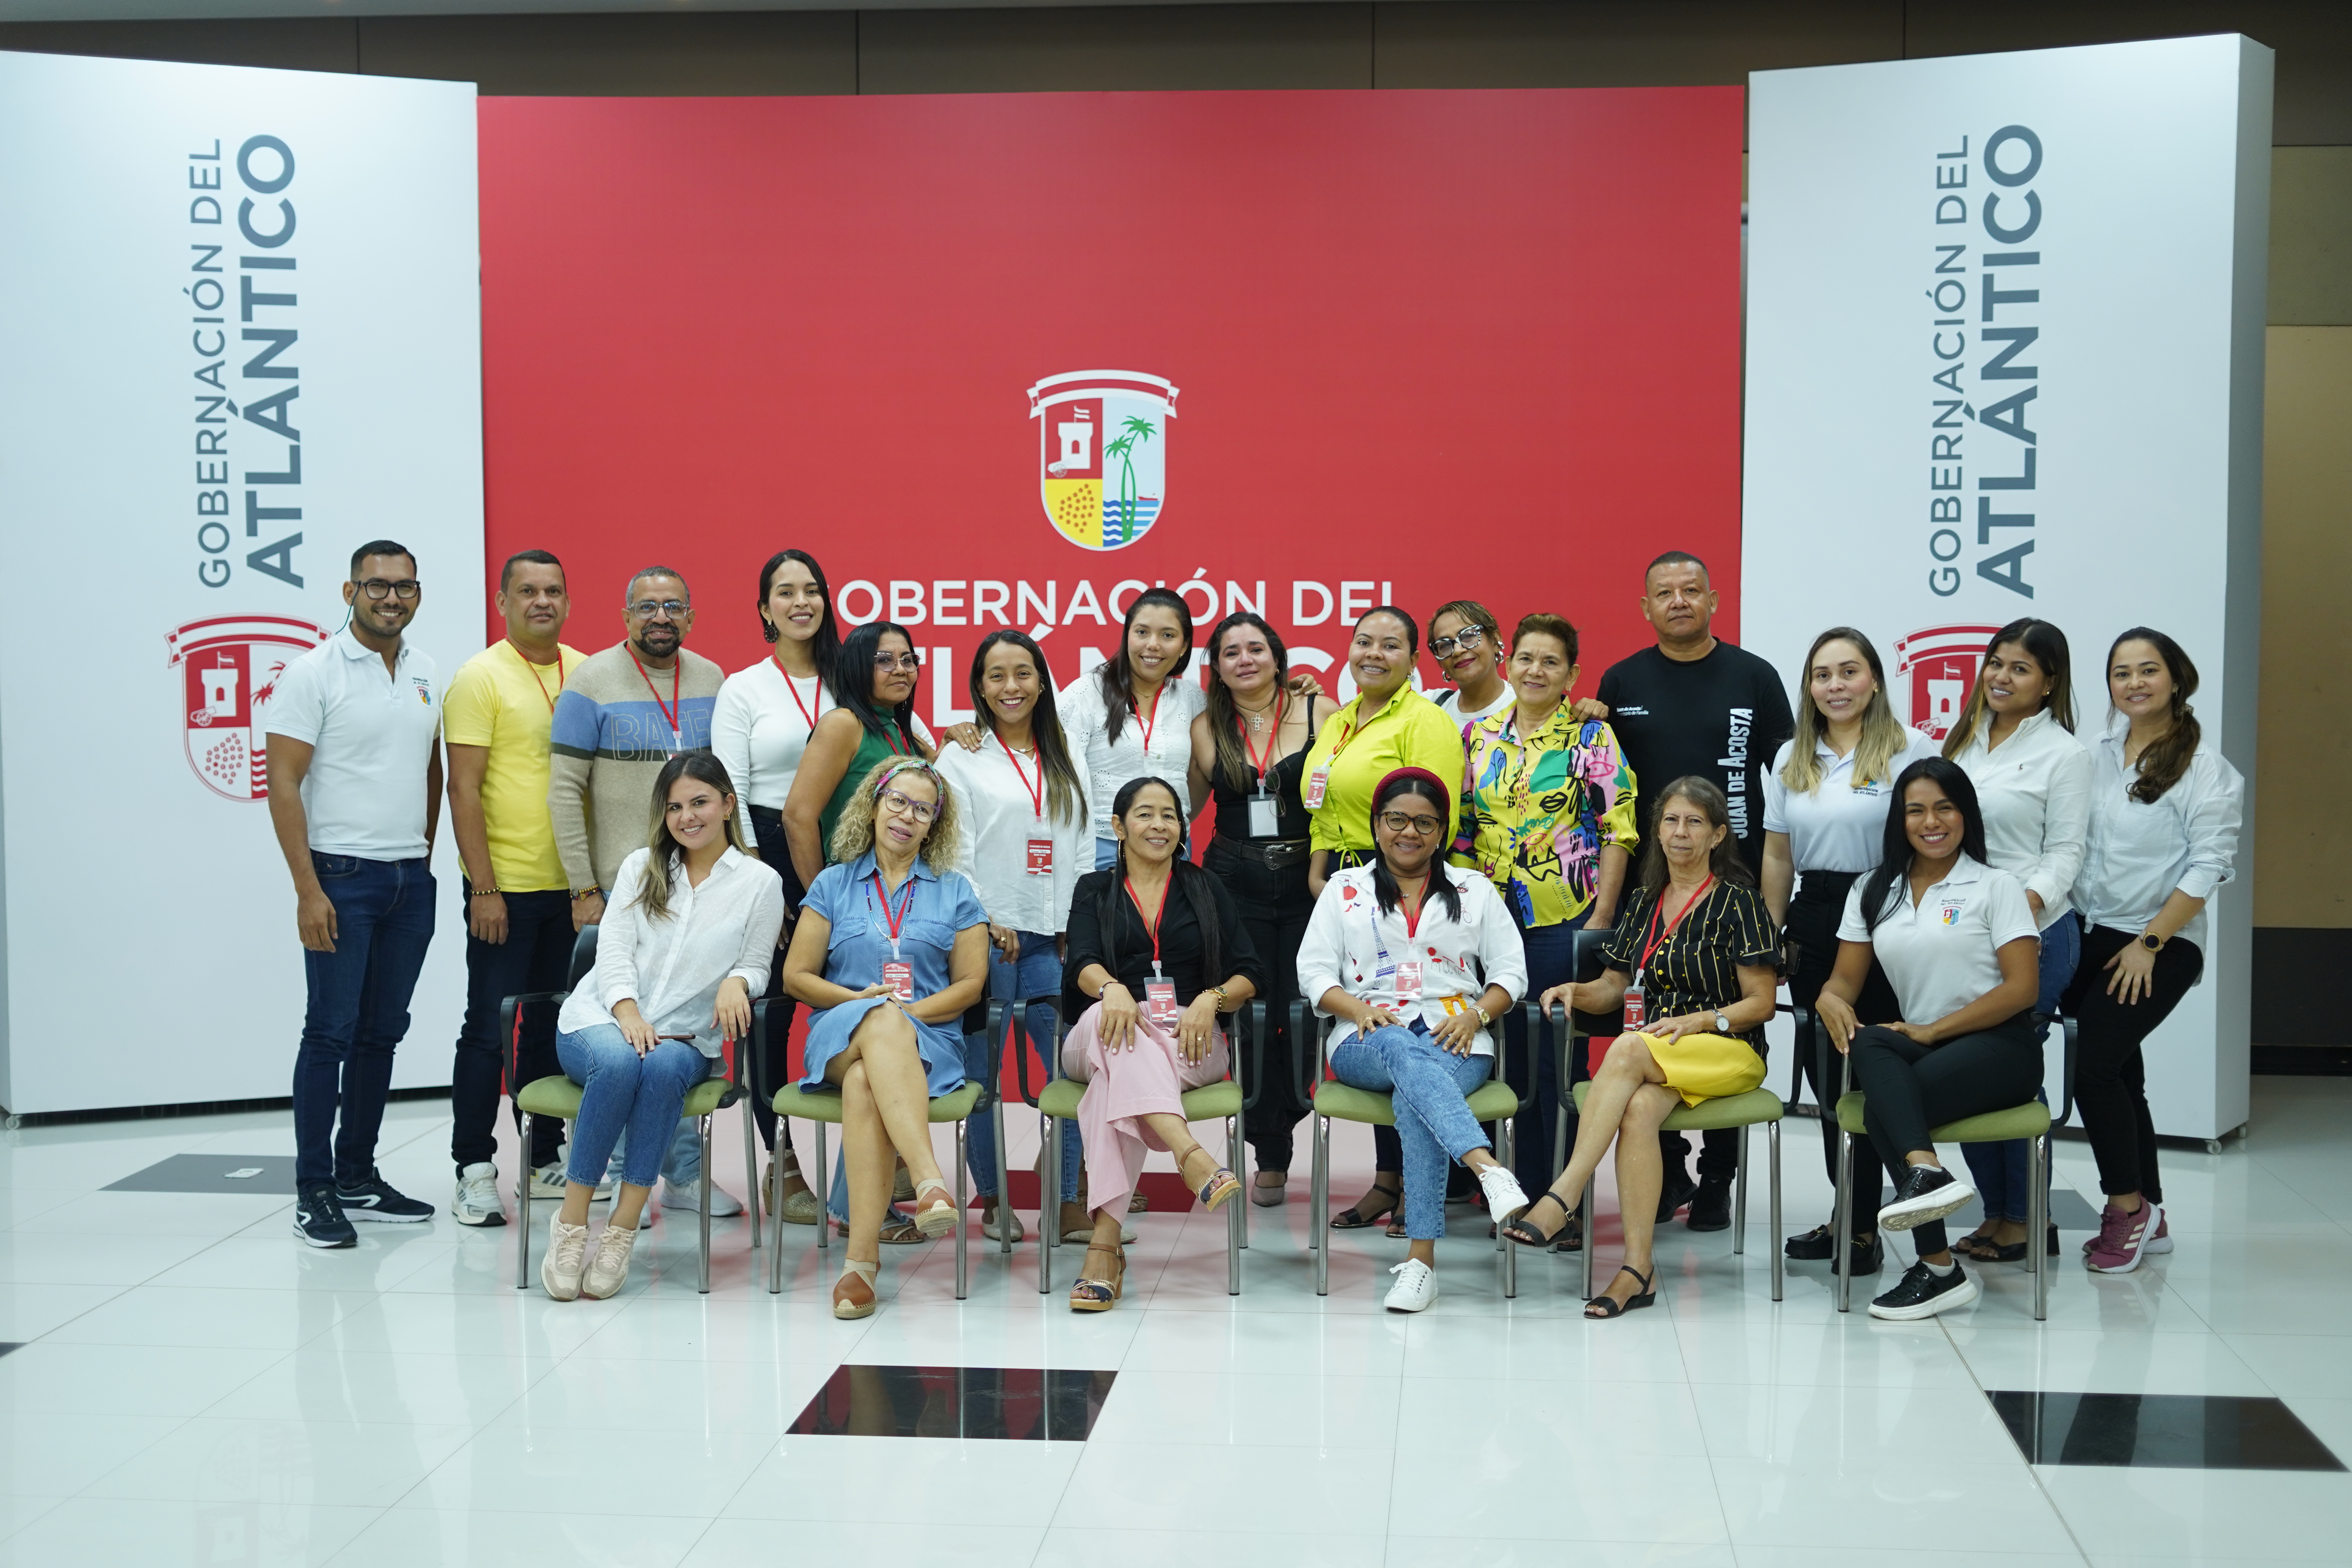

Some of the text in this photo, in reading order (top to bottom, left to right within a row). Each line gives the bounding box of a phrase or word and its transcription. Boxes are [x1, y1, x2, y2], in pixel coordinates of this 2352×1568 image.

[183, 140, 230, 588] GOBERNACIÓN DEL
[226, 135, 304, 589] ATLÁNTICO
[1926, 135, 1968, 597] GOBERNACIÓN DEL
[1962, 125, 2043, 600] ATLÁNTICO
[827, 567, 1266, 626] OBERNACÓN
[1717, 708, 1753, 839] JUAN DE ACOSTA
